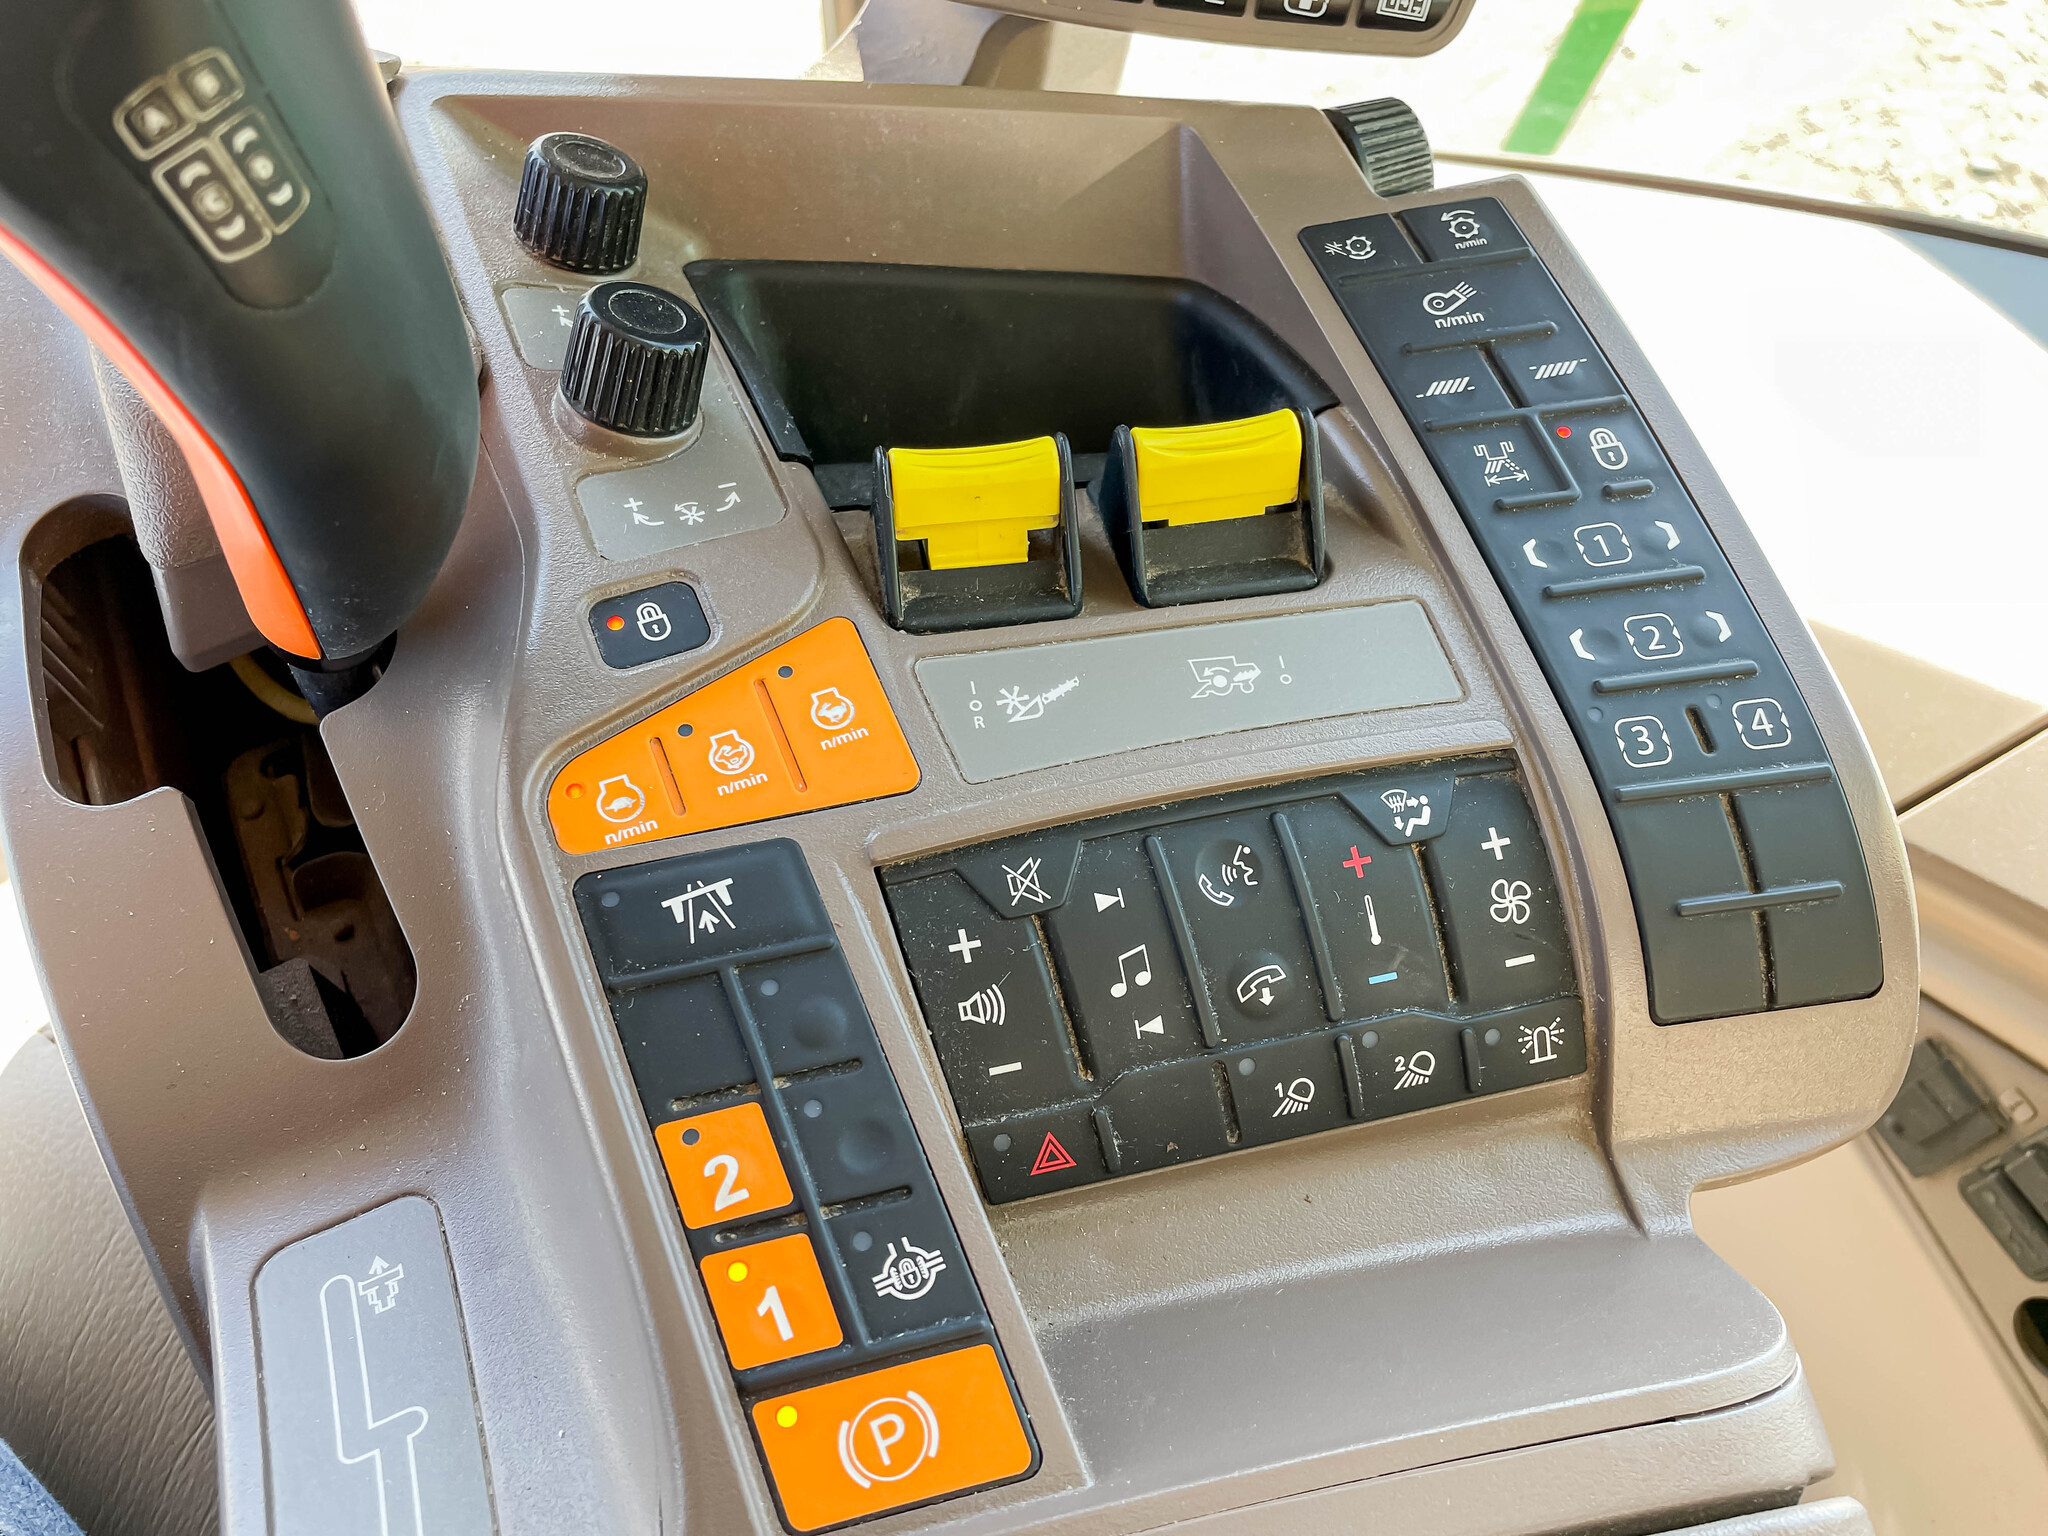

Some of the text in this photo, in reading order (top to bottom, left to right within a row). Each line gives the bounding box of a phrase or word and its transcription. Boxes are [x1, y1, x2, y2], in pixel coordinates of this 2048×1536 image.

[1455, 237, 1487, 250] n/min
[1435, 312, 1485, 329] n/min
[1593, 534, 1611, 558] 1
[1647, 625, 1667, 651] 2
[973, 716, 986, 729] R
[1751, 708, 1774, 737] 4
[820, 726, 869, 750] n/min
[1630, 725, 1655, 756] 3
[717, 771, 768, 797] n/min
[604, 819, 659, 845] n/min
[1394, 1056, 1406, 1072] 2
[1274, 1082, 1284, 1098] 1
[703, 1154, 750, 1213] 2
[757, 1285, 795, 1342] 1
[869, 1413, 906, 1466] P
